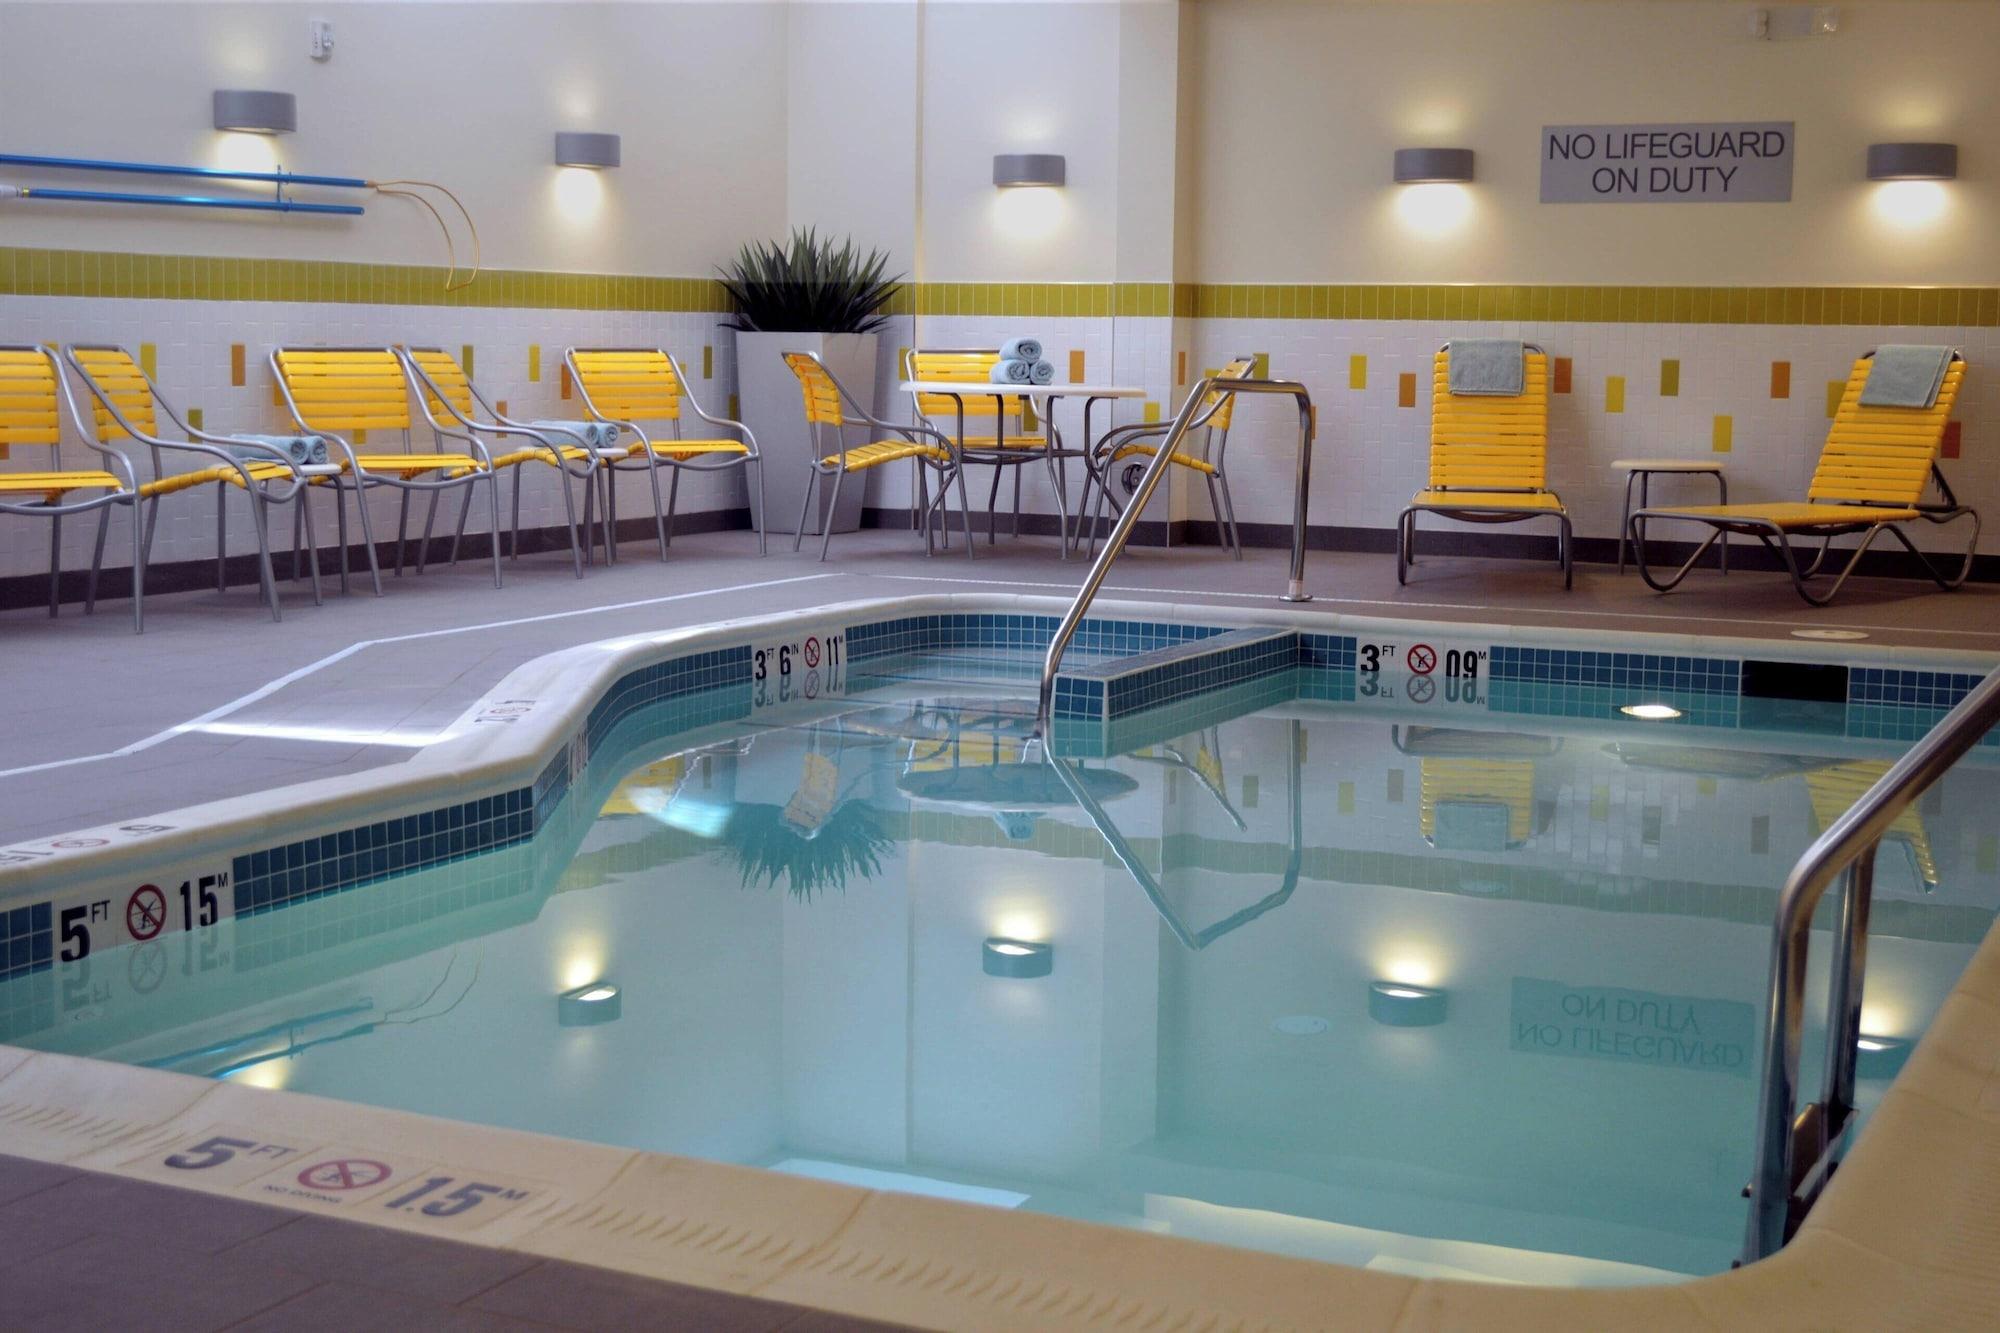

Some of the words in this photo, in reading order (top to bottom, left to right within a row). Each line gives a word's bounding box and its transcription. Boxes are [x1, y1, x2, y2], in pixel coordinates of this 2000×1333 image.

[1549, 133, 1596, 160] NO
[1605, 131, 1785, 159] LIFEGUARD
[1592, 167, 1638, 193] ON
[1649, 166, 1738, 193] DUTY
[755, 650, 767, 680] 3
[779, 645, 791, 675] 6
[1360, 644, 1380, 671] 3
[1382, 645, 1396, 657] FT
[1478, 651, 1487, 660] M
[60, 905, 91, 962] 5
[91, 900, 111, 924] FT
[217, 872, 229, 888] M
[164, 1136, 258, 1170] 5
[248, 1144, 299, 1160] FT
[499, 1188, 530, 1201] M
